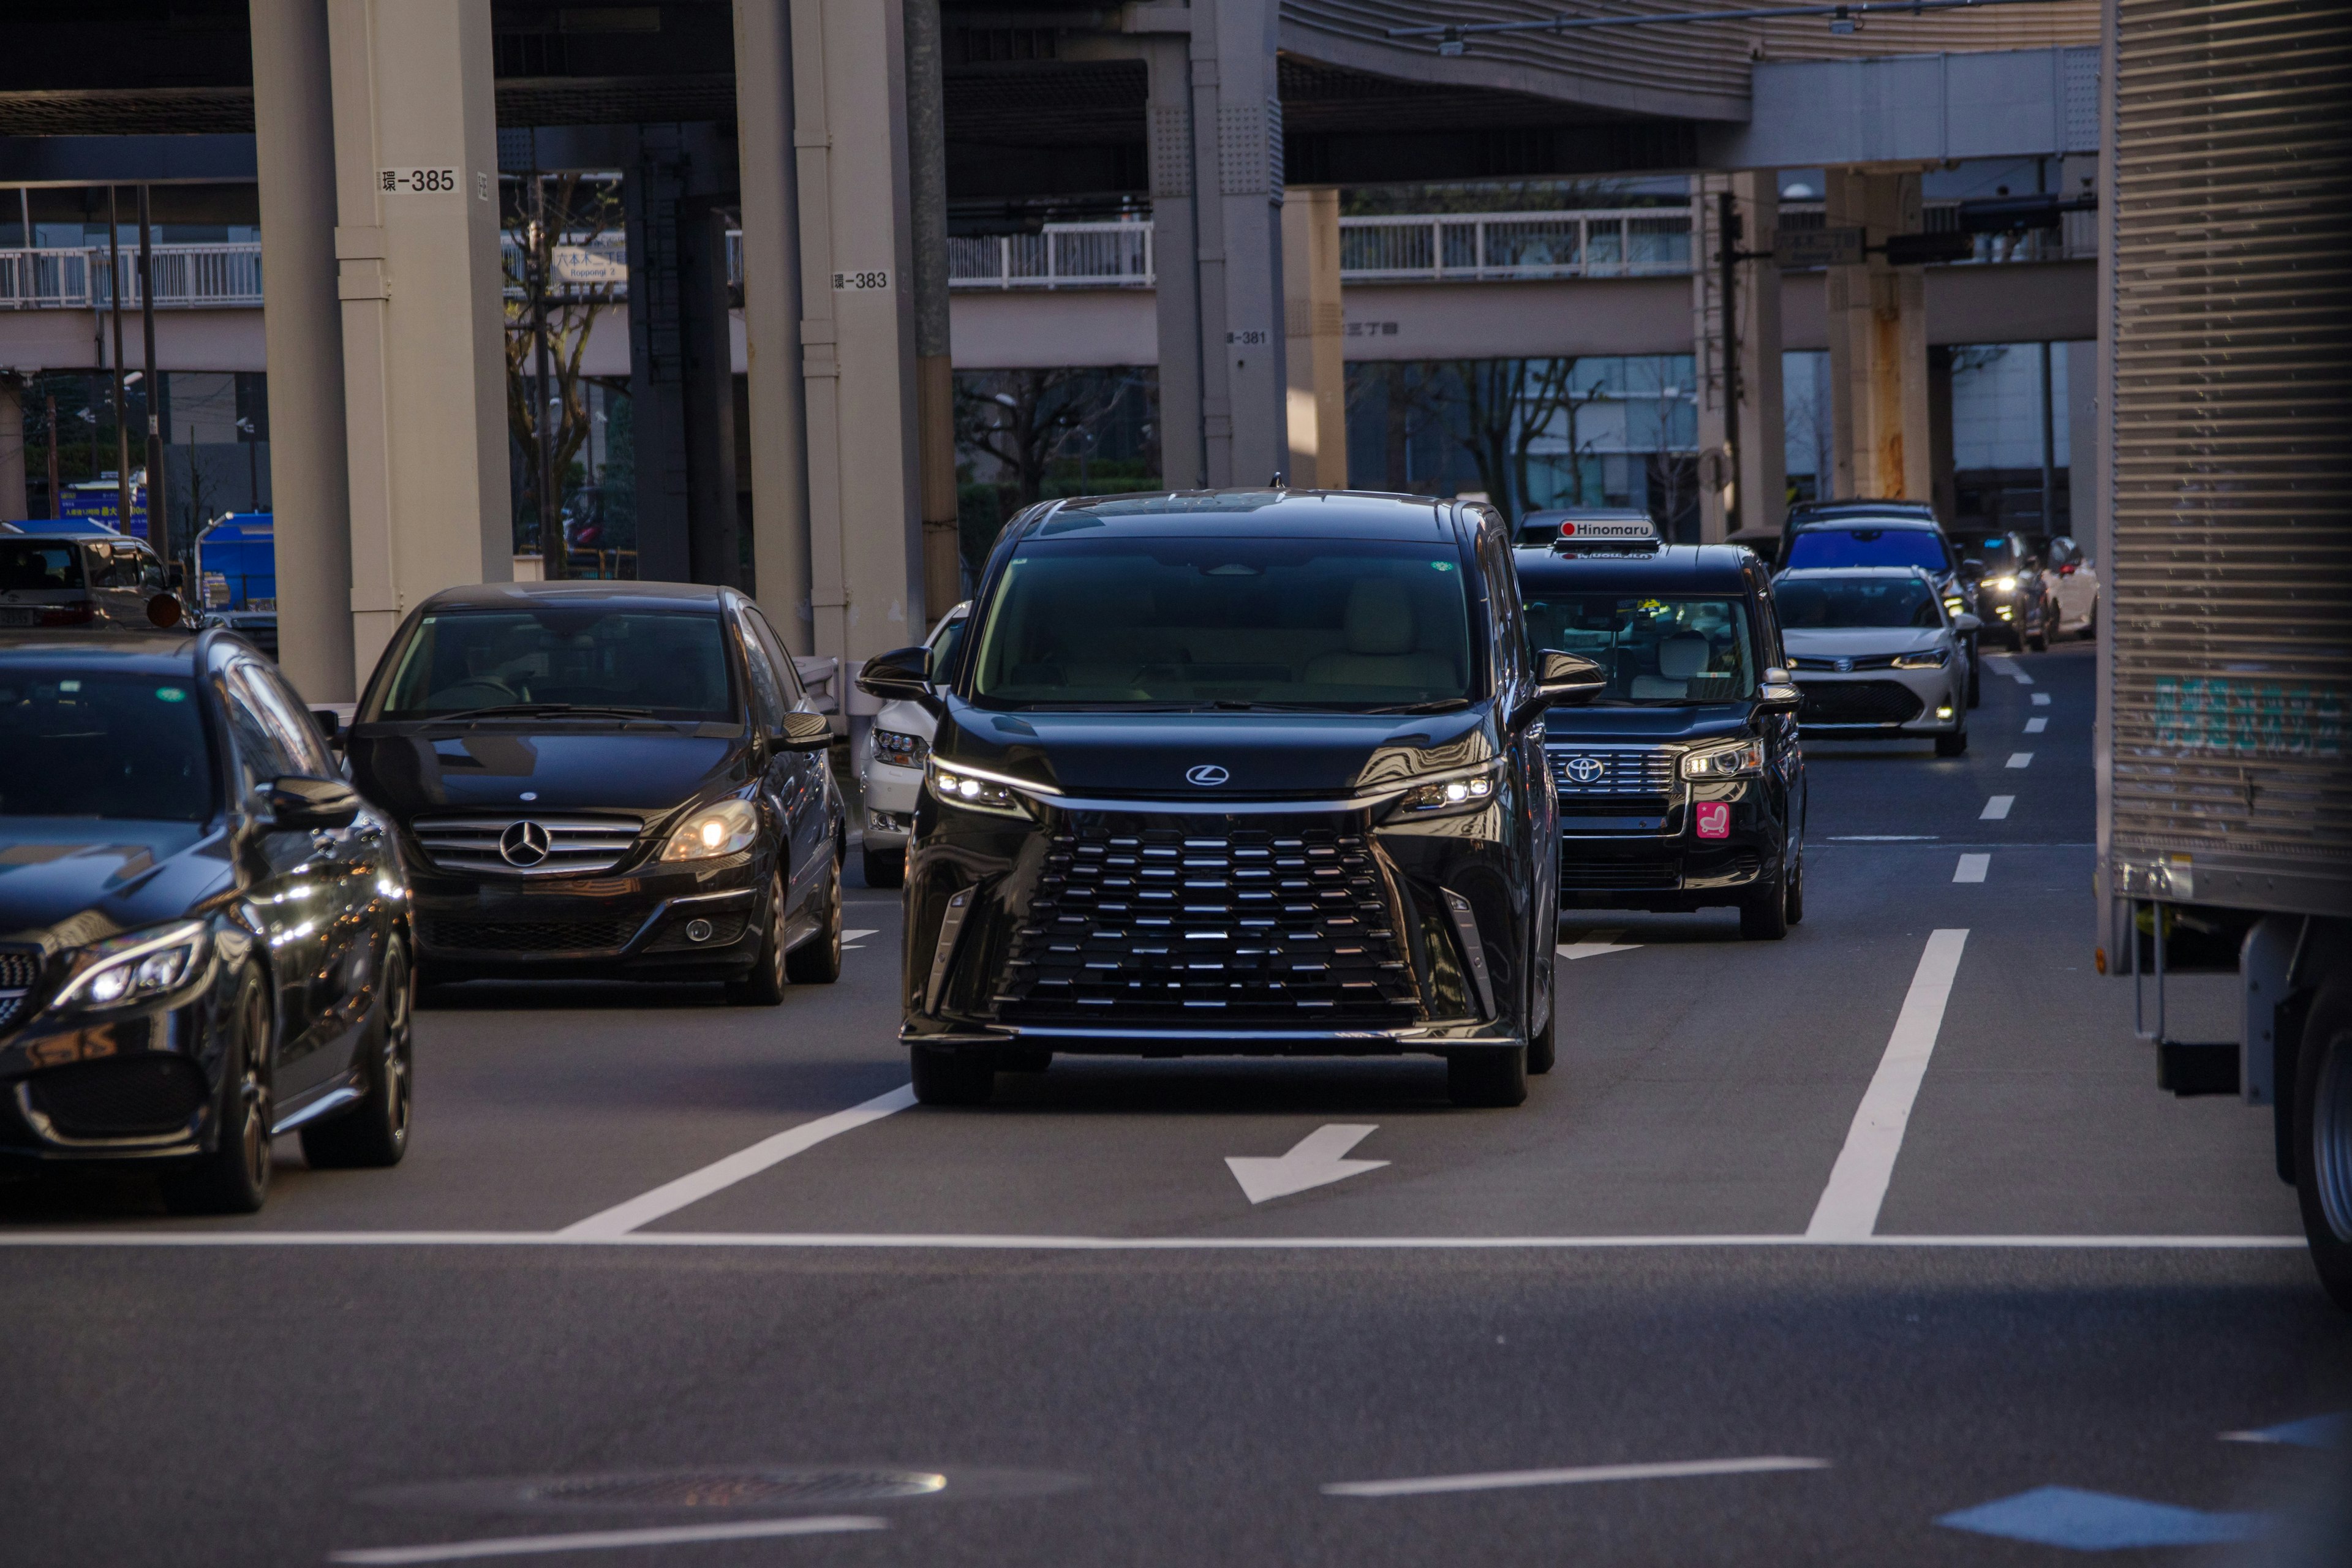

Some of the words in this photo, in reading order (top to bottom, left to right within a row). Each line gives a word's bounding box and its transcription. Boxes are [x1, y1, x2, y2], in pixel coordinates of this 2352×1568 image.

[382, 170, 454, 192] 環-385
[556, 251, 628, 266] 六本木二丁目
[570, 268, 606, 277] Roppongi
[610, 267, 616, 276] 2
[834, 272, 887, 289] 環-383
[1343, 322, 1398, 336] 三丁目
[1577, 524, 1648, 535] Hinomaru
